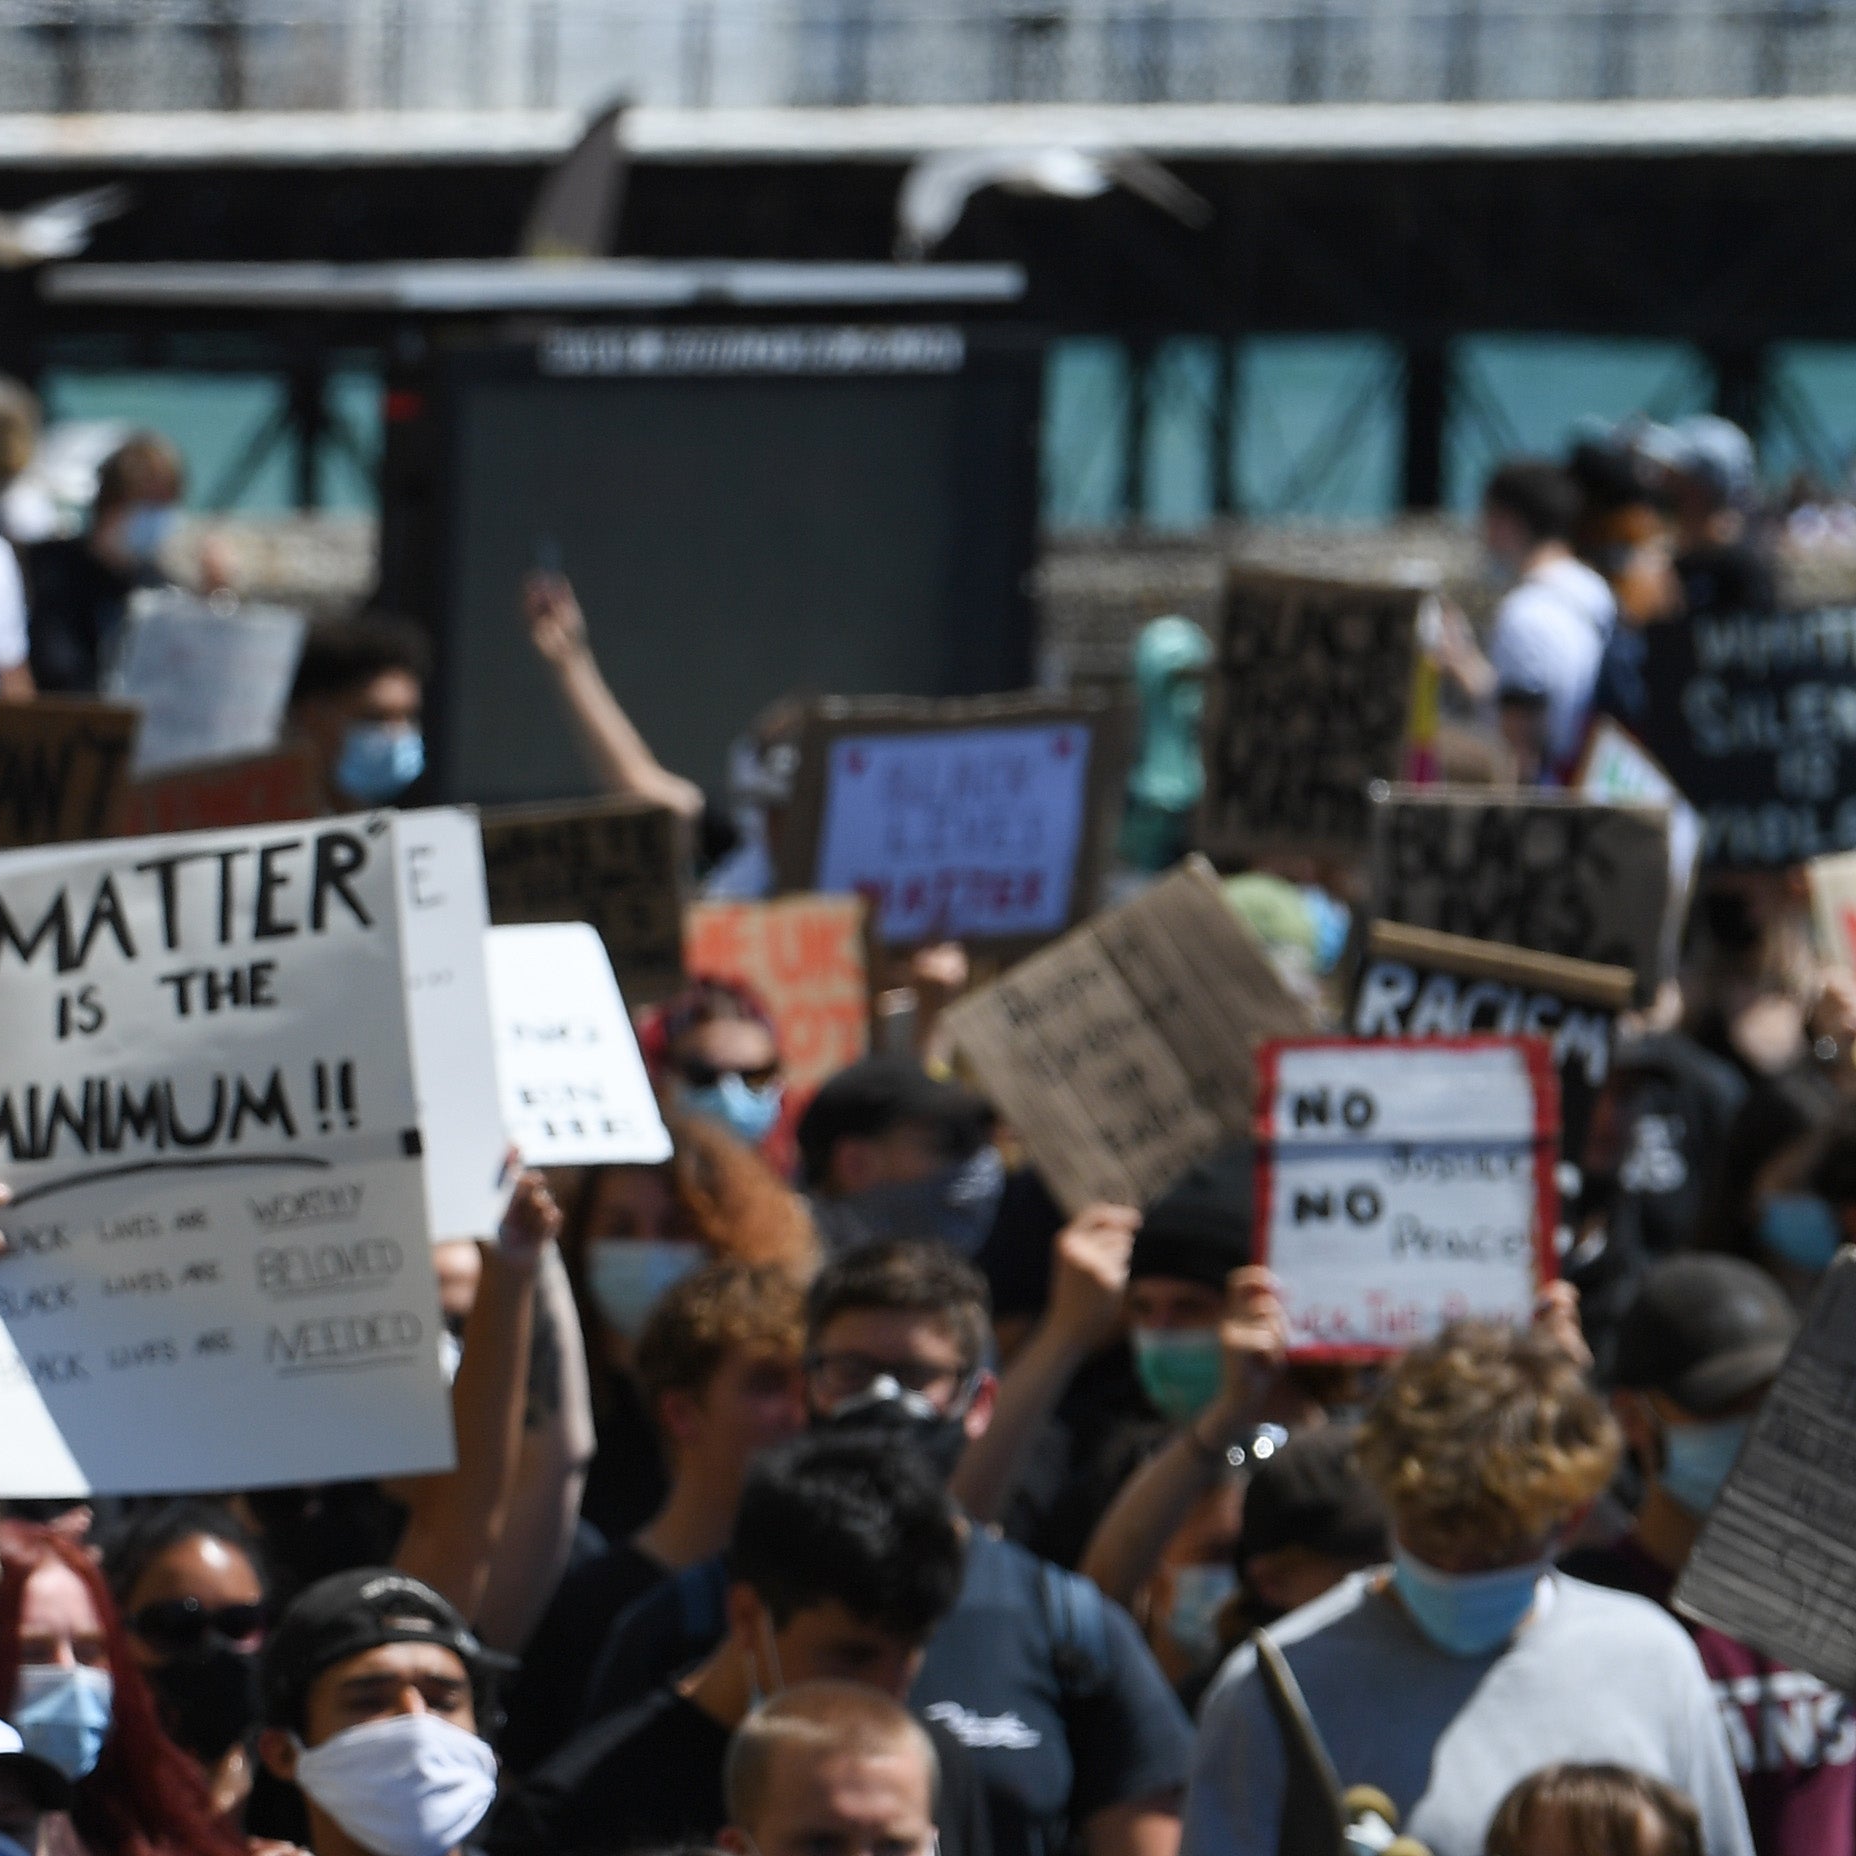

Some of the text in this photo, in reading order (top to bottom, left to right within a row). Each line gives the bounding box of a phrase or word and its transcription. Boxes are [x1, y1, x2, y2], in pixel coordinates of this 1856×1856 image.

[55, 960, 278, 1041] IS THE
[1292, 1087, 1377, 1132] NO
[96, 1211, 165, 1242] LIVES
[174, 1207, 208, 1232] ARE
[1292, 1185, 1383, 1228] NO
[102, 1267, 173, 1298] LIVES
[179, 1260, 221, 1286] ARE
[253, 1235, 404, 1292] BELOVED
[108, 1338, 178, 1372] LIVES
[194, 1328, 234, 1358] ARE
[264, 1311, 427, 1365] NEEDED
